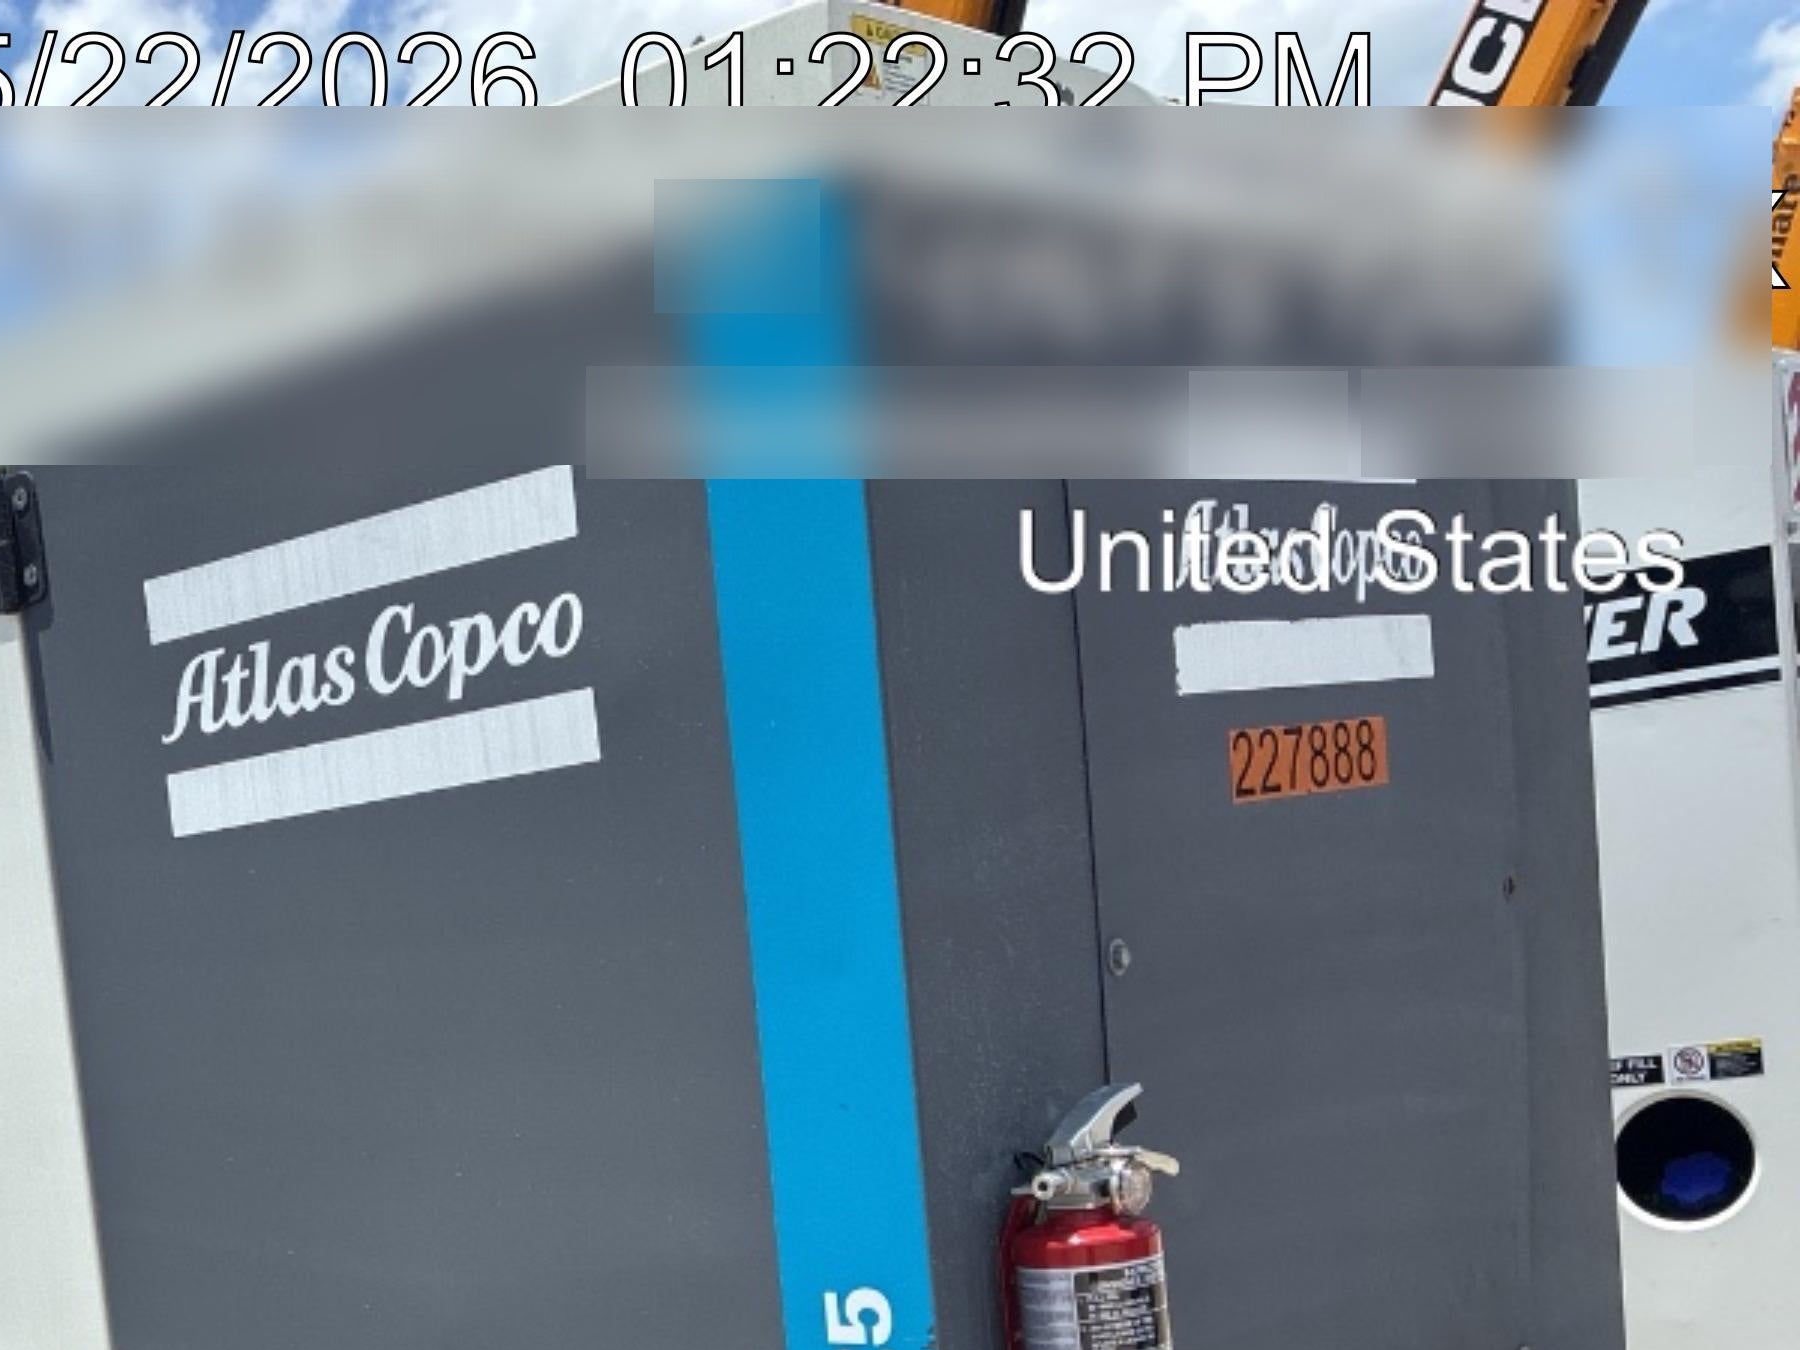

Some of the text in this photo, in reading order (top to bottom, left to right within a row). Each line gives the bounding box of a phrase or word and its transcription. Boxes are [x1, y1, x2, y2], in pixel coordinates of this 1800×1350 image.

[1584, 587, 1708, 662] ER
[162, 592, 584, 743] Atlas Copco
[1231, 718, 1378, 798] 227888
